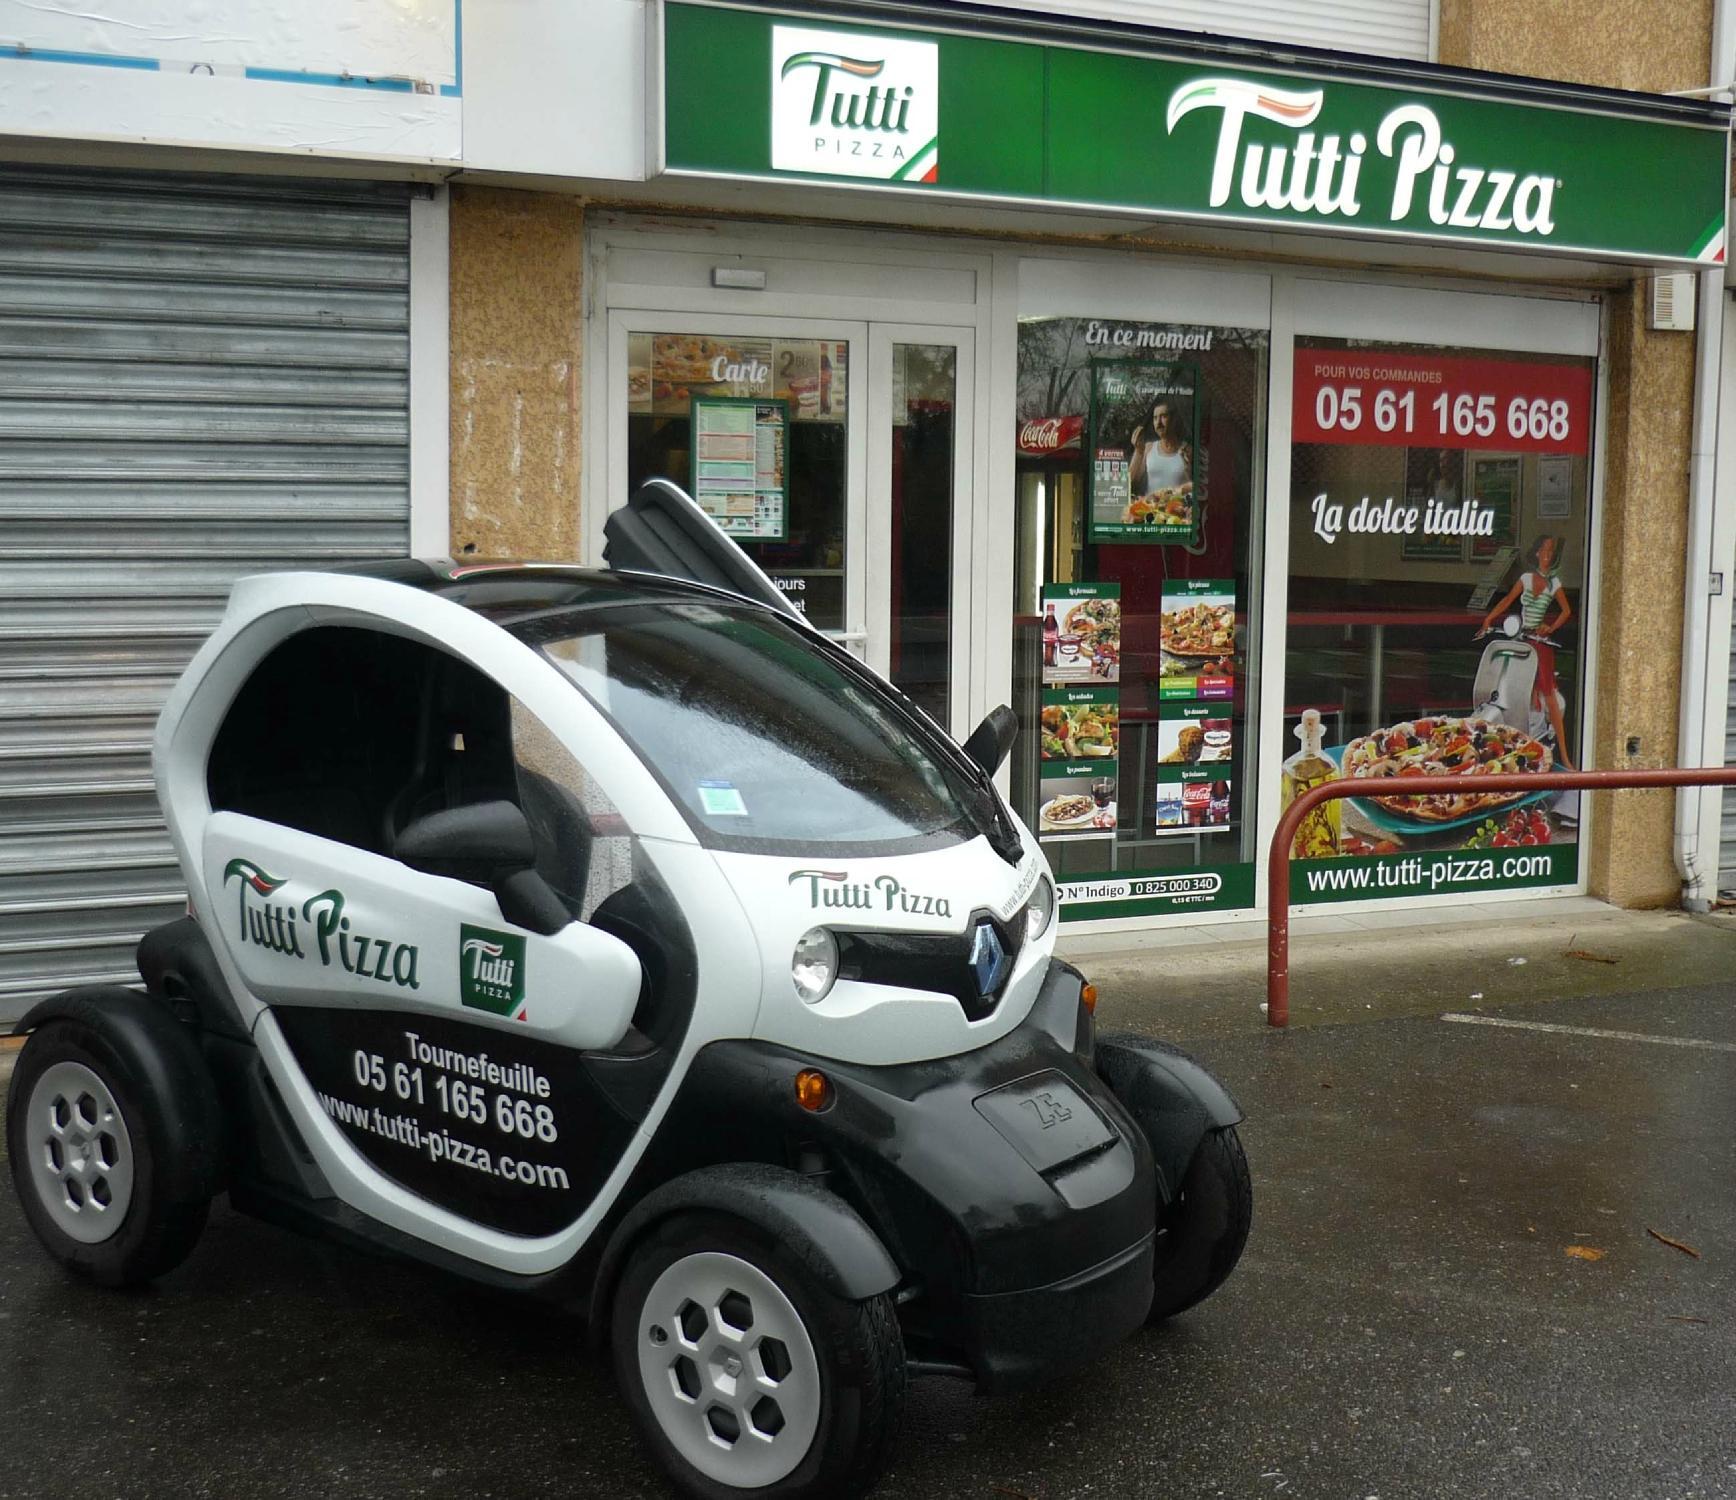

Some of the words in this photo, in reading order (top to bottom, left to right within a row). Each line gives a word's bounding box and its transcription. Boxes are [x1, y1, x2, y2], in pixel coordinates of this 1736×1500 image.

[781, 51, 913, 134] Tutti
[814, 136, 906, 160] PIZZA
[1166, 77, 1368, 218] Tutti
[1376, 103, 1556, 236] Pizza
[1085, 321, 1110, 346] En
[1115, 327, 1133, 347] ce
[1136, 328, 1213, 352] moment
[712, 355, 768, 384] Carte
[1314, 364, 1346, 380] POUR
[1348, 366, 1371, 381] VOS
[1372, 368, 1443, 384] COMMANDES
[1315, 386, 1361, 432] 05
[1374, 390, 1414, 434] 61
[1432, 393, 1497, 438] 165
[1507, 398, 1569, 442] 668
[1311, 493, 1342, 545] La
[1348, 496, 1417, 535] dolce
[1424, 498, 1495, 537] italia
[788, 870, 873, 910] Tutti
[874, 875, 952, 918] Pizza
[1086, 886, 1125, 899] Indigo
[1135, 883, 1144, 894] 0
[1145, 881, 1167, 894] 825
[1169, 879, 1190, 892] 000
[1192, 878, 1213, 890] 340
[1307, 852, 1552, 892] www.tutti-pizza.com
[223, 858, 305, 959] Tutti
[302, 889, 420, 991] Pizza
[463, 939, 515, 988] Tutti
[474, 983, 512, 1001] PIZZA
[404, 1032, 552, 1099] Tournefeuille
[354, 1050, 386, 1092] 05
[394, 1062, 426, 1105] 61
[436, 1076, 487, 1125] 165
[495, 1093, 558, 1144] 668
[318, 1091, 571, 1191] www.tutti-pizza.com
